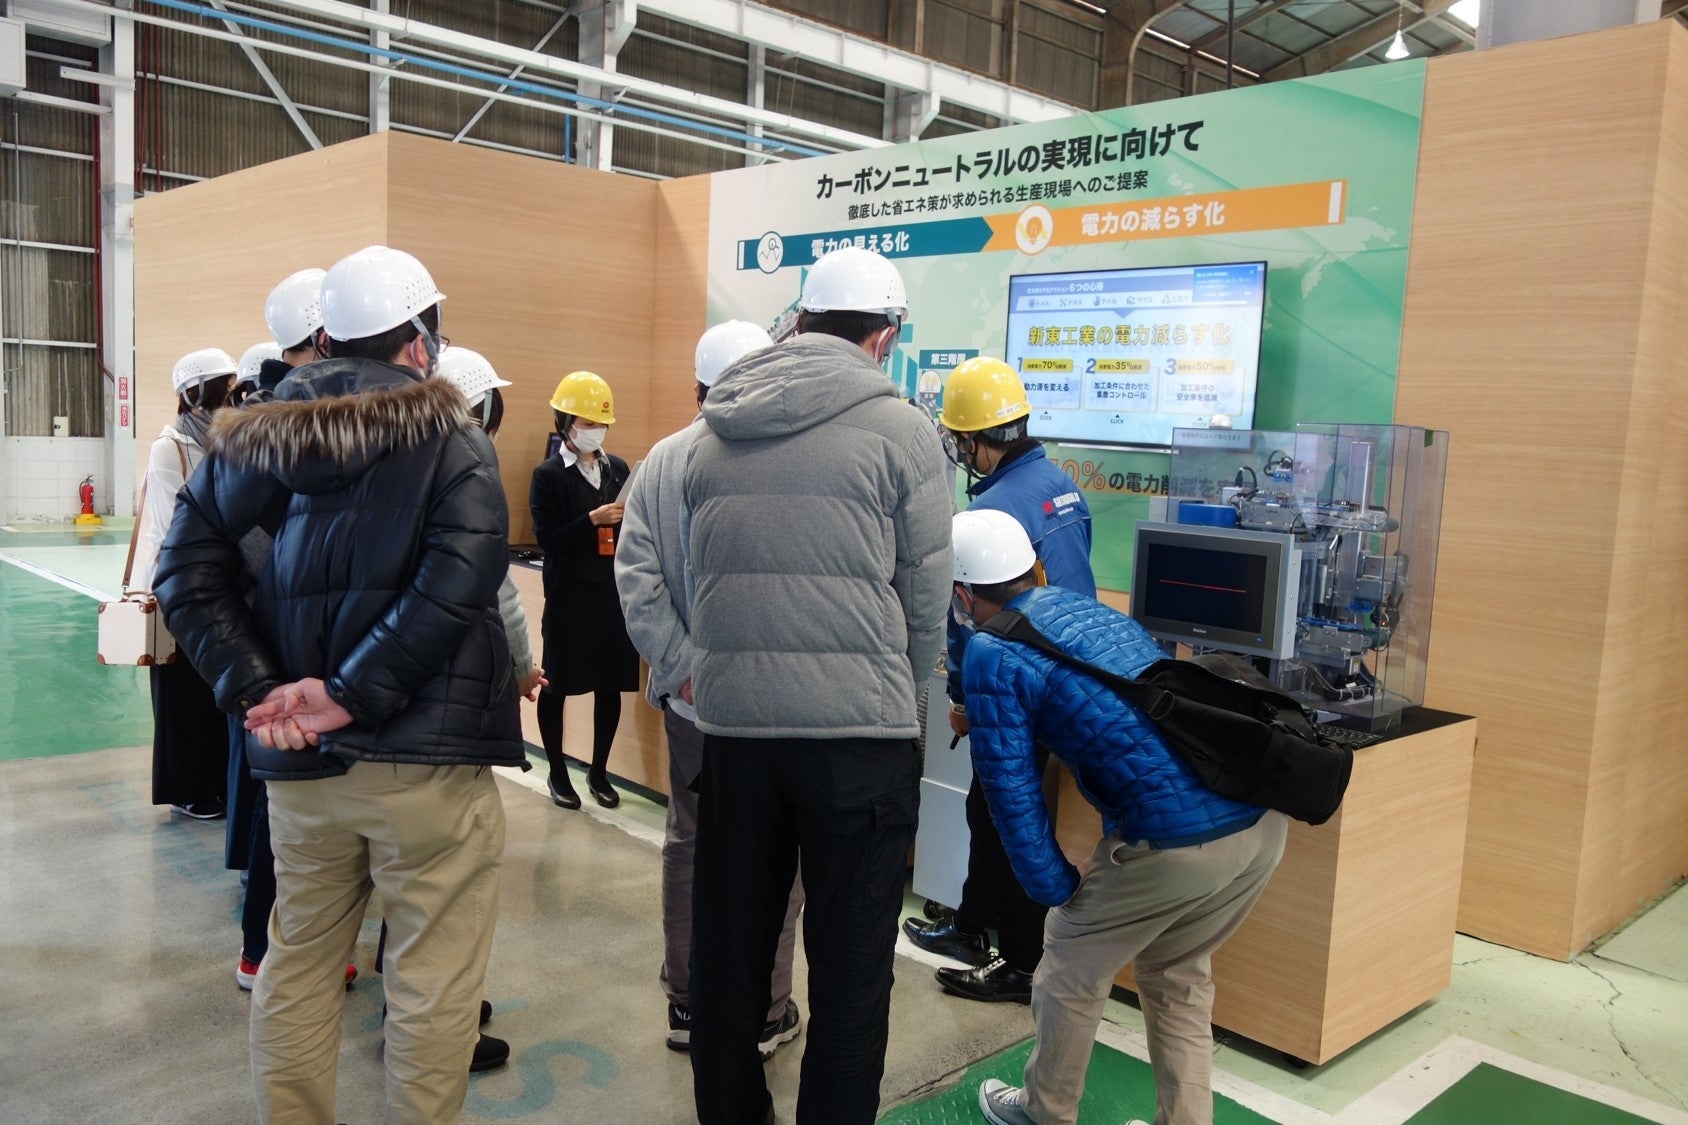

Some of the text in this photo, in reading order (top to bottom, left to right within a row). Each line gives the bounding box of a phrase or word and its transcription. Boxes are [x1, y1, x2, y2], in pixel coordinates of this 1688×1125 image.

[816, 120, 1204, 200] カーボンニュートラルの実現に向けて
[847, 169, 1149, 221] 徹底した省エネ策が求められる生産現場へのご提案
[1081, 201, 1226, 236] 電力の減らす化
[1029, 323, 1231, 347] 新東工業の電力減らす化
[1017, 357, 1023, 373] 1
[1085, 358, 1097, 374] 2
[1165, 358, 1177, 375] 3
[1094, 382, 1150, 391] 加工条件に合わせた
[1180, 384, 1216, 393] 加工条件の
